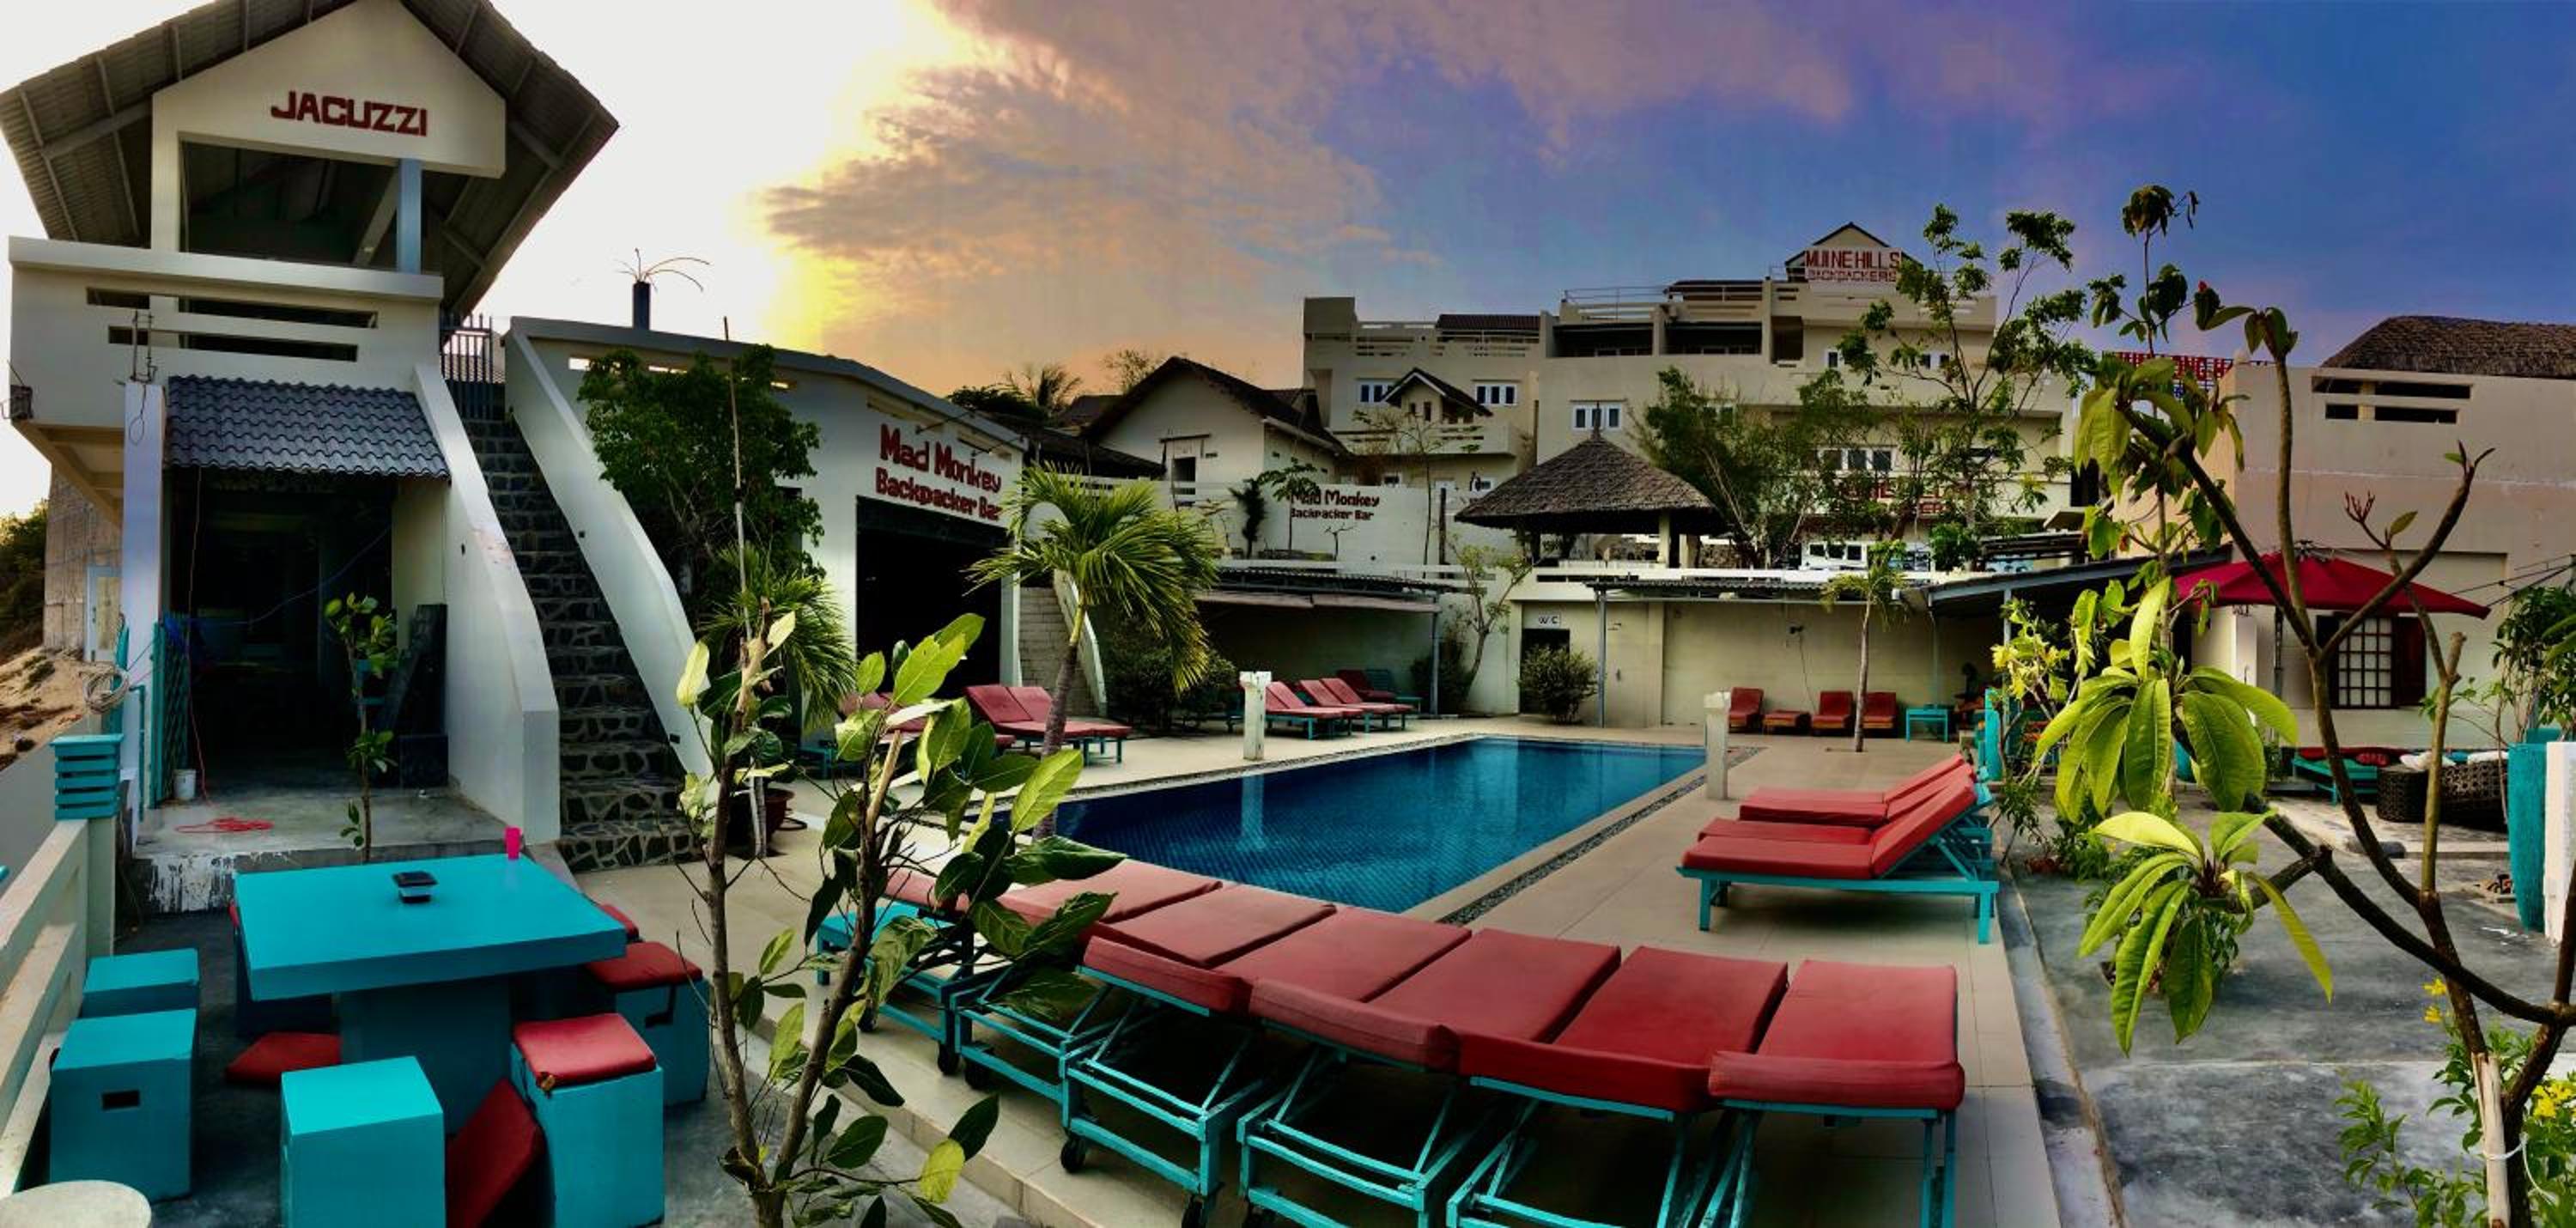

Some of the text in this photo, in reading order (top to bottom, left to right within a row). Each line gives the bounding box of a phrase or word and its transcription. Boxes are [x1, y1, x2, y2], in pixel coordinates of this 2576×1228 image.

[270, 90, 428, 137] JACUZZI
[1855, 250, 1900, 269] HILLS
[880, 423, 1002, 493] Mad Monkey
[875, 466, 977, 515] Backpacker
[1325, 489, 1380, 507] Monkey
